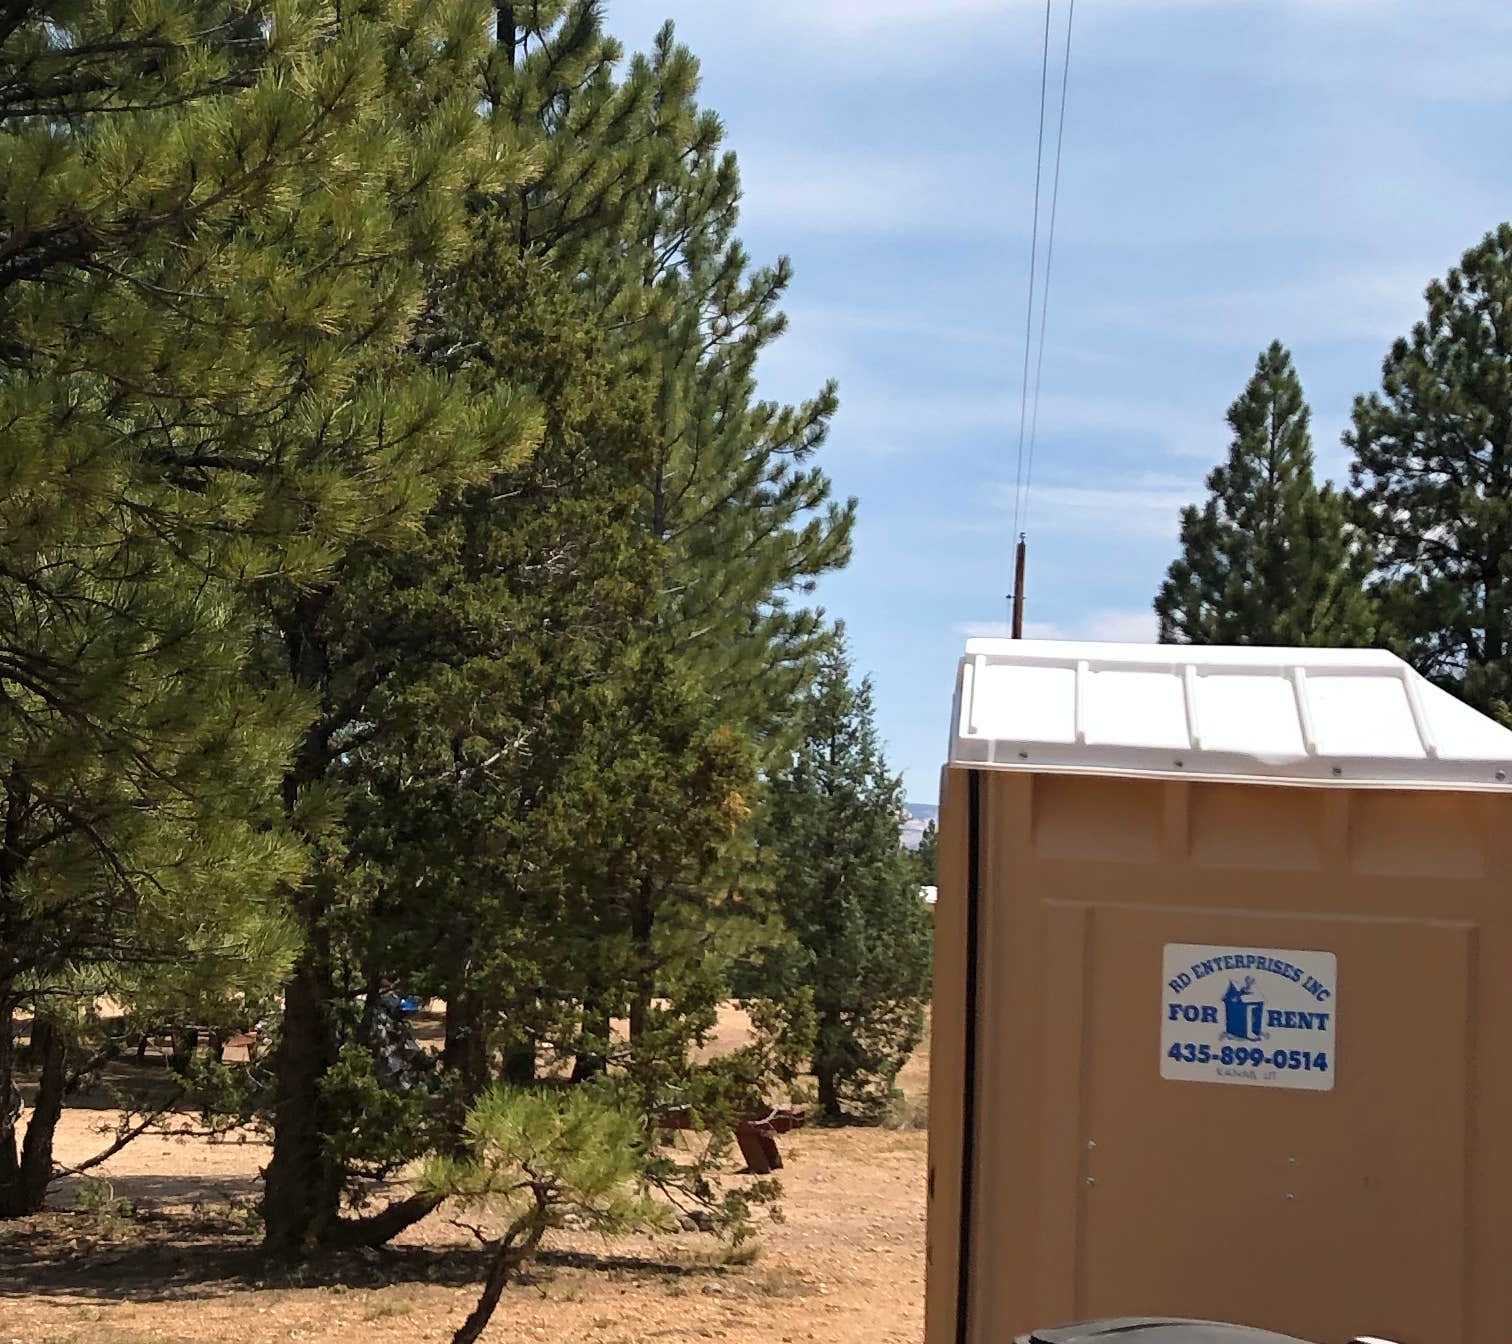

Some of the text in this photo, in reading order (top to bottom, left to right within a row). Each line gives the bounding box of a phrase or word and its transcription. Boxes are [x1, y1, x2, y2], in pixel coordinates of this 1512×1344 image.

[1190, 954, 1305, 983] ENTERPRISES
[1302, 976, 1331, 1002] INC
[1168, 1003, 1330, 1031] FOR RENT
[1168, 1042, 1328, 1072] 435-899-0514
